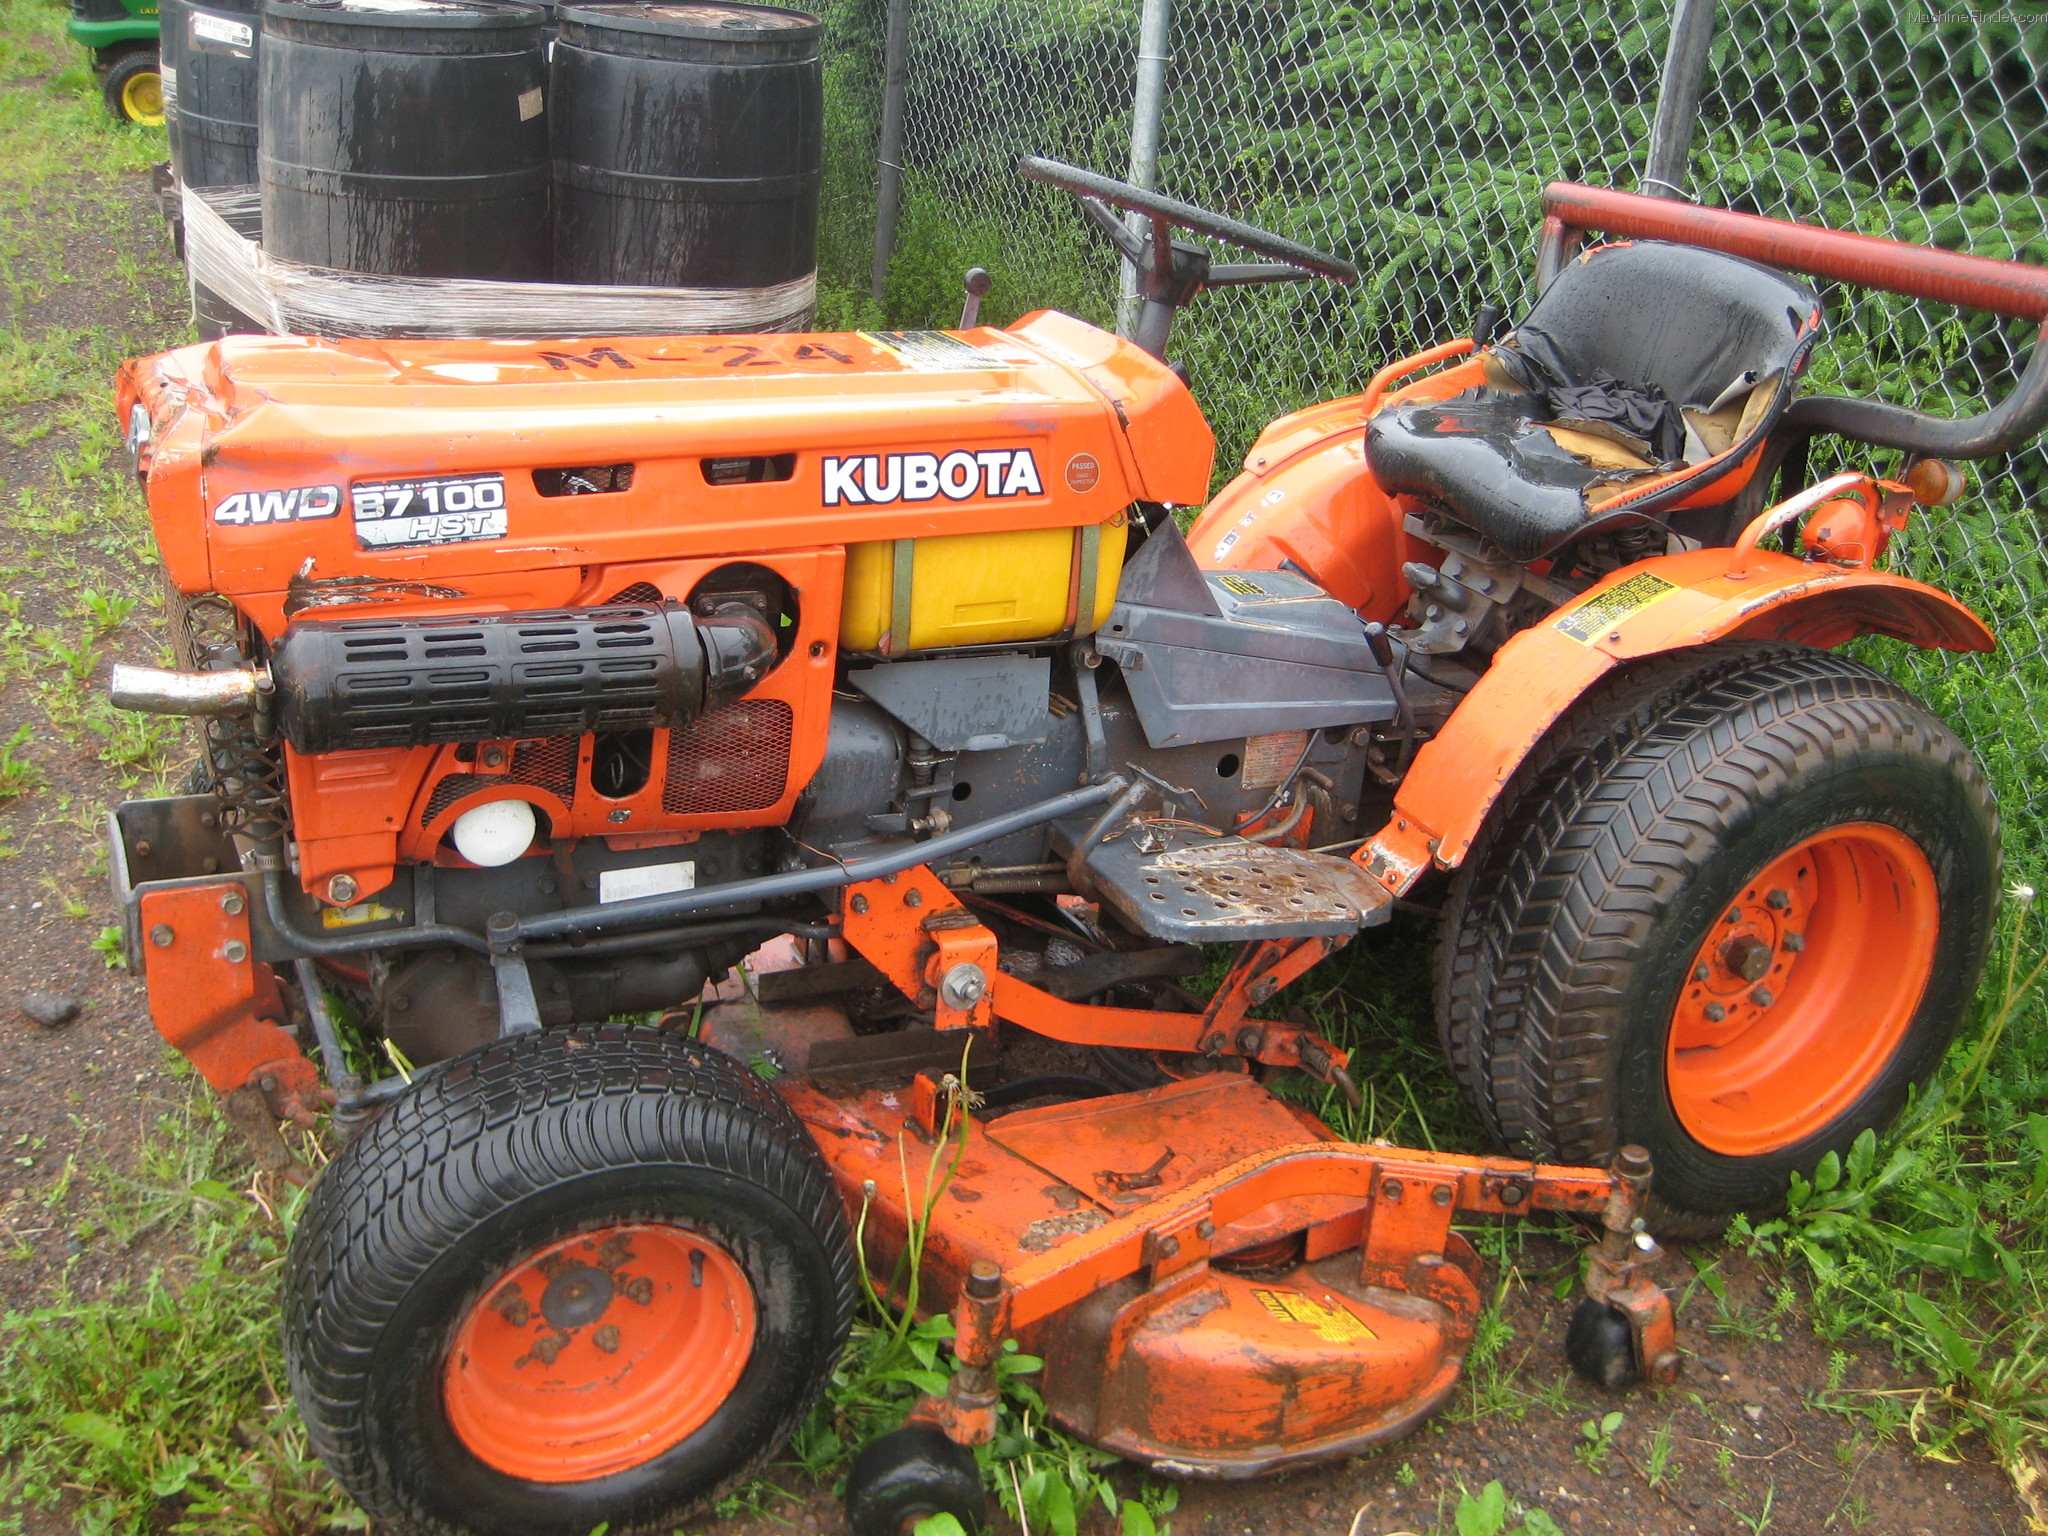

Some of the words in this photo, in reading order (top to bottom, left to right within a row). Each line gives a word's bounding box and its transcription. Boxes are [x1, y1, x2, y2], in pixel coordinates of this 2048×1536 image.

[822, 448, 1044, 506] KUBOTA
[213, 485, 341, 525] 4WD
[353, 482, 504, 520] B7100
[408, 512, 492, 539] HST
